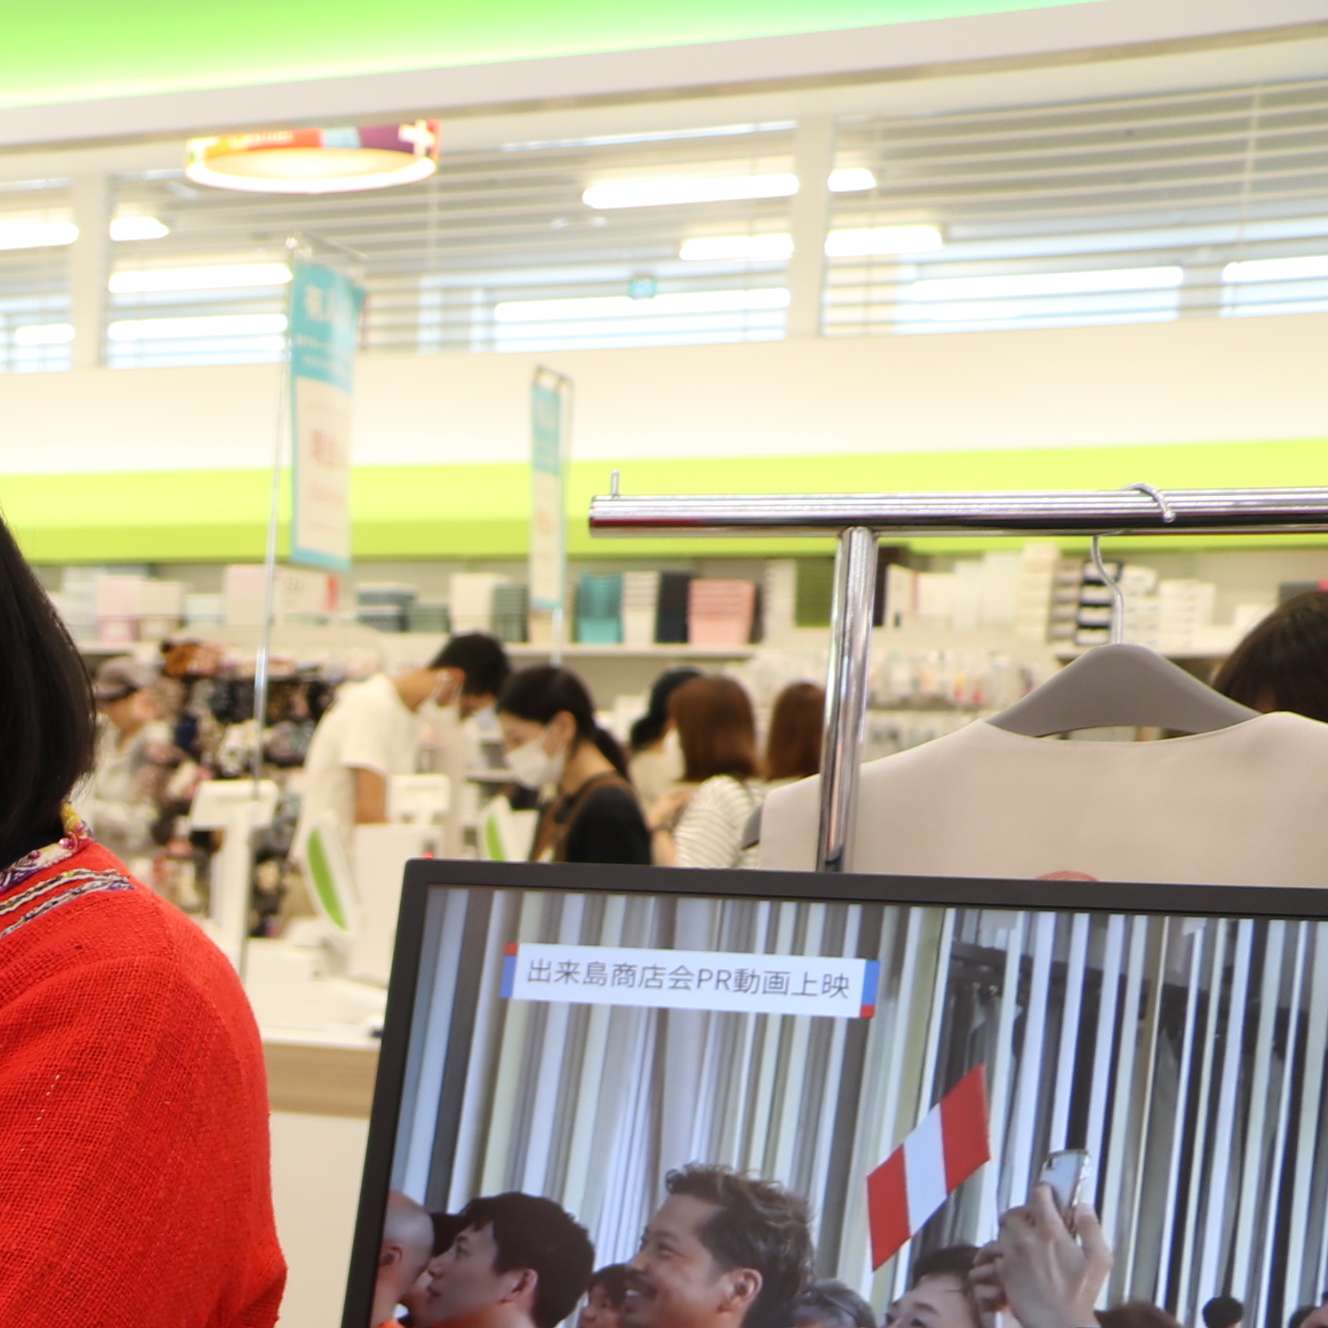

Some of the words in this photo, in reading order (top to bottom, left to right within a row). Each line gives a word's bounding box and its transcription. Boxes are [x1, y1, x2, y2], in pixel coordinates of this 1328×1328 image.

[526, 958, 851, 999] 出来島商店会PR動画上映
